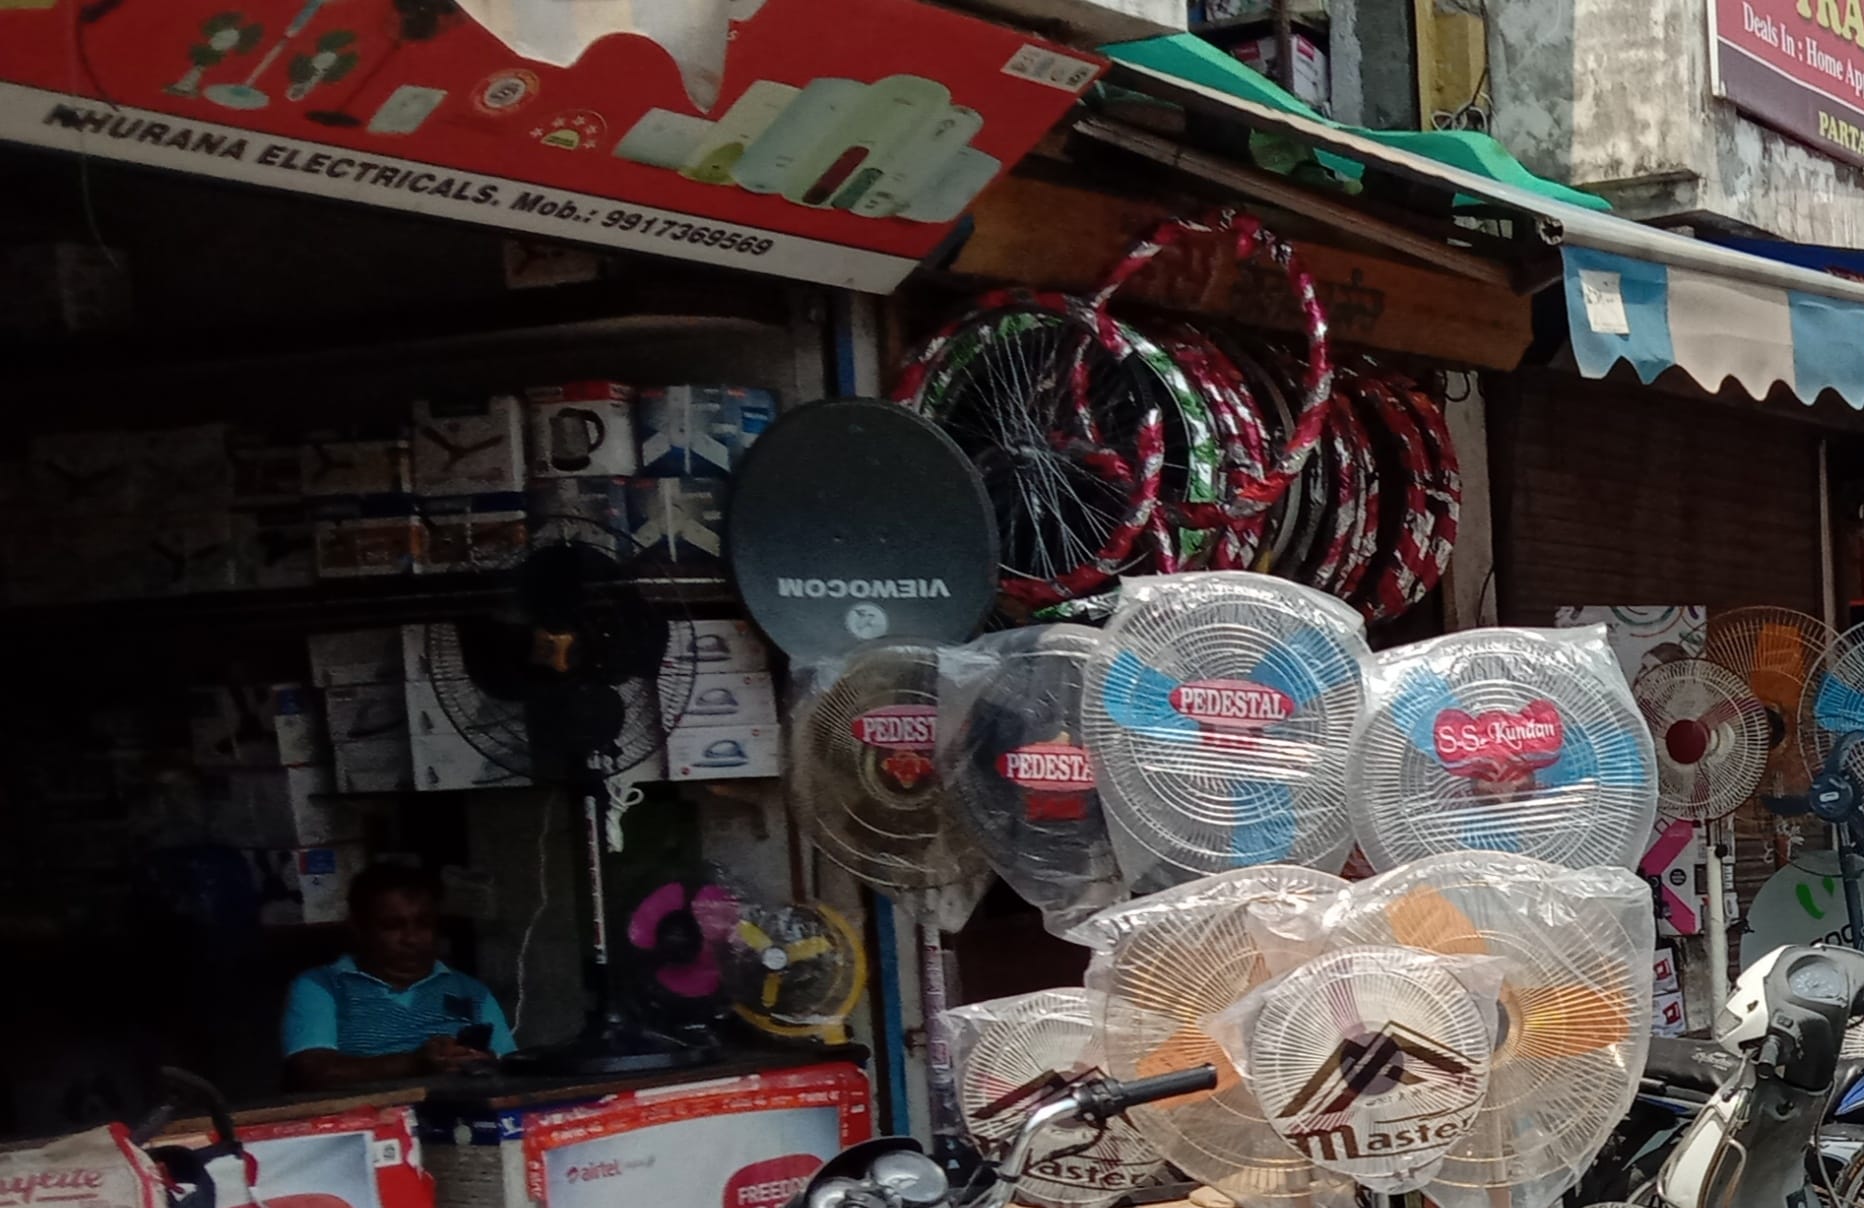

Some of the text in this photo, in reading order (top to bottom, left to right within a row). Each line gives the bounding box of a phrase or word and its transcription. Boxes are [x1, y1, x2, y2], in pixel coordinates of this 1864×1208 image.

[1743, 2, 1778, 47] Deals
[1780, 25, 1796, 56] In
[1805, 37, 1844, 80] Home
[256, 143, 500, 207] ELECTRICALS.
[601, 209, 775, 256] 9917369569
[777, 576, 954, 600] VIEWOCOM
[1177, 684, 1288, 720] PEDESTAL
[862, 714, 937, 745] PEDEST
[1005, 752, 1092, 782] PEDESTA
[580, 1159, 622, 1182] airtel
[737, 1176, 808, 1206] FREEDO
